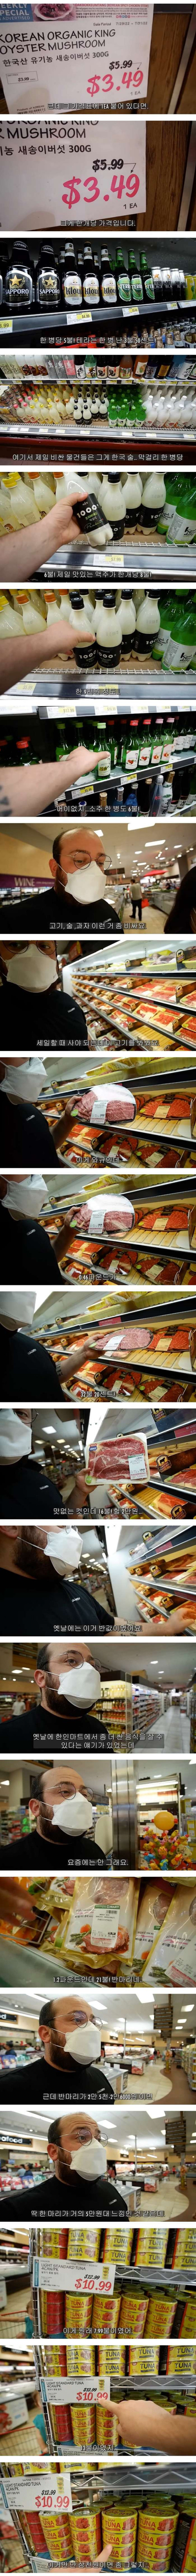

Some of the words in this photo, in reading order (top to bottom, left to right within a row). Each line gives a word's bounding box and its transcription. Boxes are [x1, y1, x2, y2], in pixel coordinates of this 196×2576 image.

[47, 30, 92, 40] ORGANIC
[94, 29, 116, 38] KING
[0, 43, 46, 54] OYSTER
[48, 39, 106, 51] MUSHROOM
[2, 58, 28, 67] 한국산
[31, 56, 53, 64] 유기농
[56, 52, 90, 62] 새송이버섯
[109, 60, 132, 71] $5.99
[87, 70, 144, 97] $3.49
[7, 128, 86, 139] MUSHROOM
[18, 145, 65, 155] 새송이버섯
[92, 159, 124, 172] $5.99
[62, 174, 140, 209] $3.49
[14, 877, 35, 887] WINE
[75, 2278, 112, 2291] $10.99
[76, 2392, 108, 2401] $10.99
[35, 2495, 70, 2508] $10.99
[105, 2520, 121, 2528] TUNA
